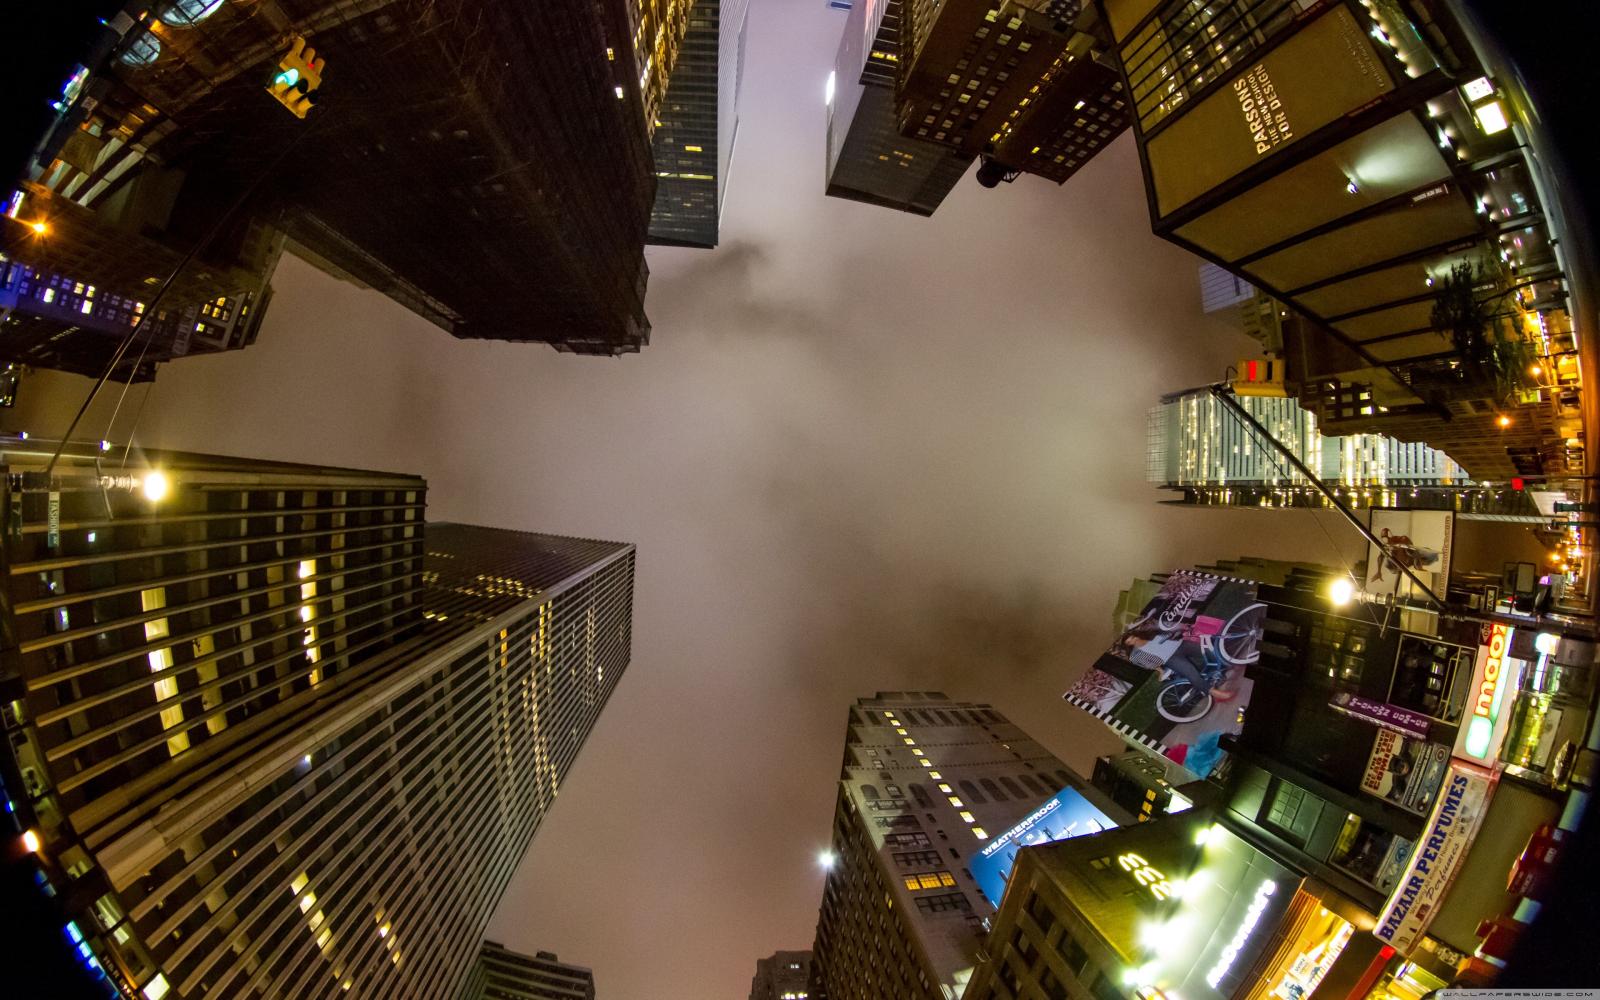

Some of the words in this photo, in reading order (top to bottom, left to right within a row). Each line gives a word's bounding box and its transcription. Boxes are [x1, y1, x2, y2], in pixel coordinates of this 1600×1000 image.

[1254, 64, 1281, 111] DESIGN
[1233, 78, 1271, 155] PARSONS
[1260, 105, 1273, 126] NEW
[1268, 126, 1281, 146] THE
[1274, 111, 1293, 140] FOR
[50, 501, 59, 534] FASHION
[1158, 578, 1203, 631] Candie's
[1349, 698, 1391, 717] MIDTOWN
[1393, 711, 1428, 728] COMICS
[1373, 733, 1397, 790] COMICS
[982, 798, 1061, 856] WEATHERPROOF
[1380, 876, 1424, 941] BAZAAR
[1416, 774, 1468, 875] PERFUMES
[1426, 842, 1460, 900] Perfumes
